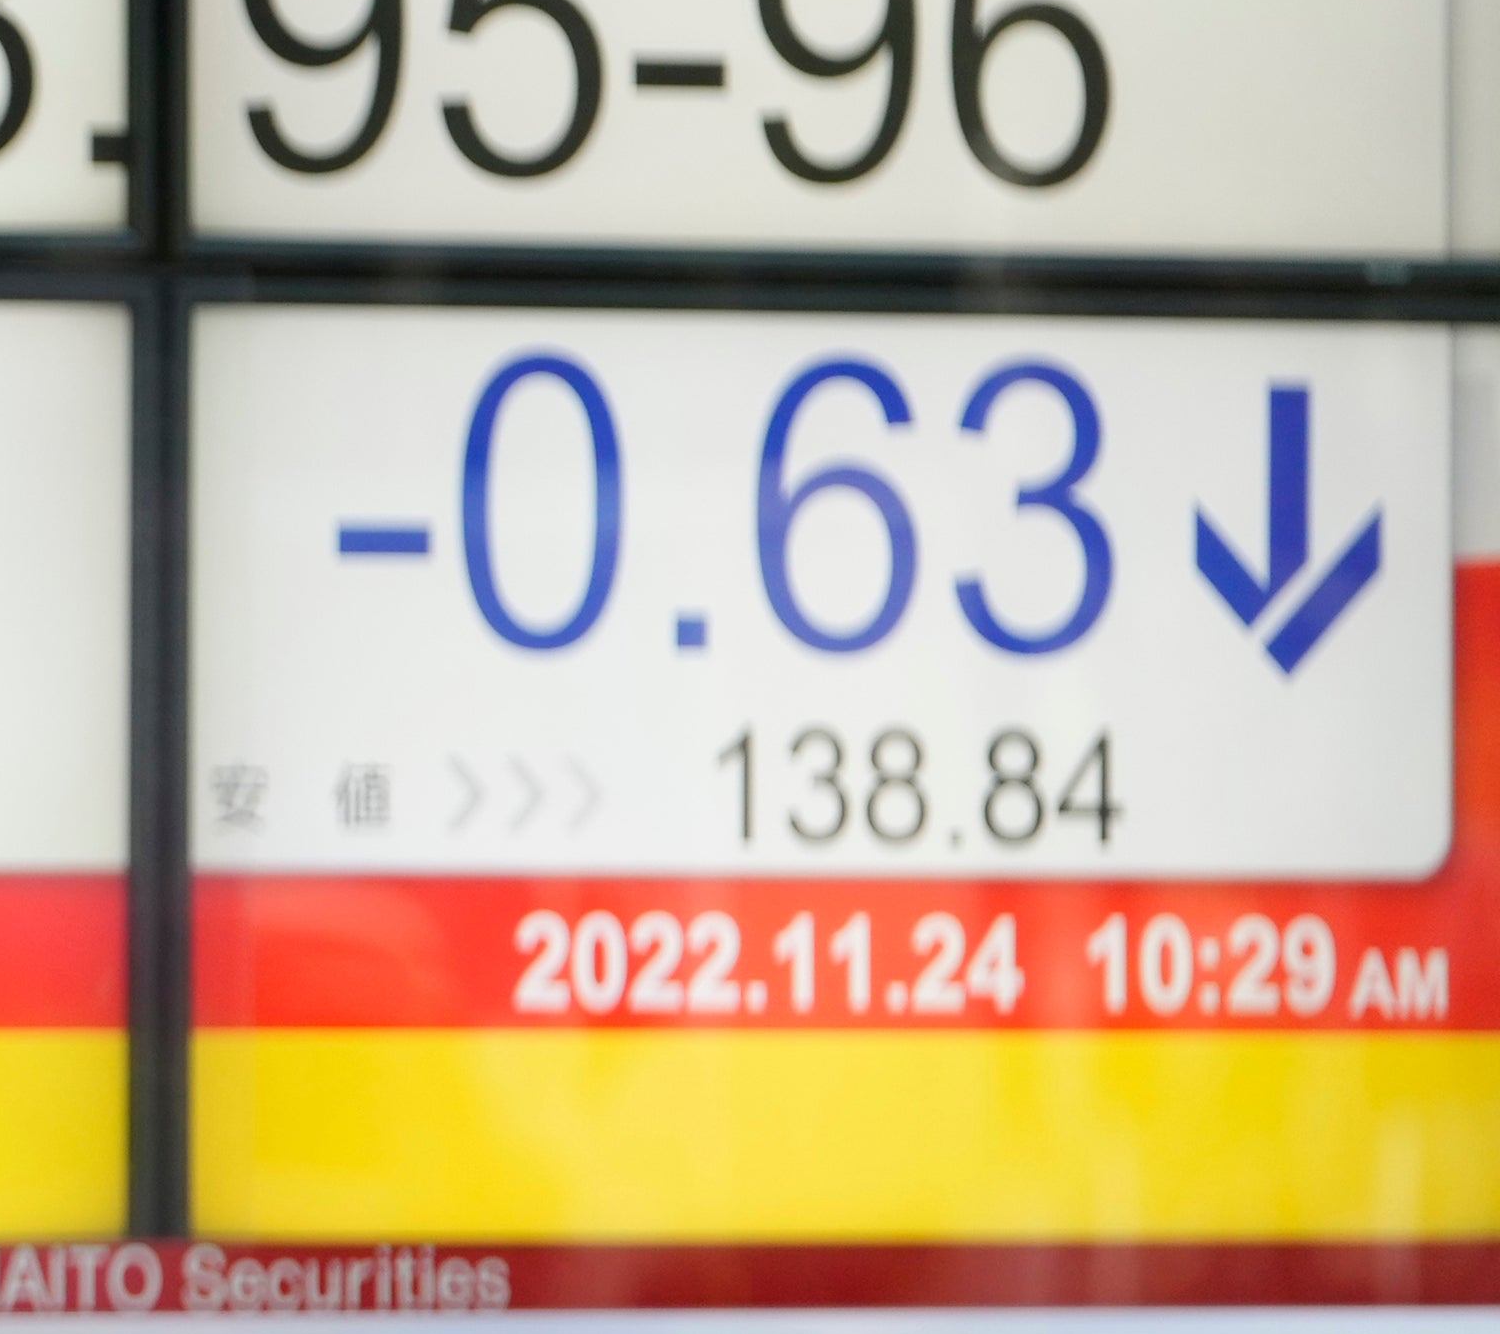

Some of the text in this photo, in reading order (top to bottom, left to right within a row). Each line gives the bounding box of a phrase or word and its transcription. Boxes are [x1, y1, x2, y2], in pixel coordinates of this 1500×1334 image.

[337, 351, 1115, 658] -0.63
[717, 726, 1124, 849] 138.84
[513, 909, 1451, 1021] 2022.11.24 10:29 AM
[181, 1243, 512, 1312] Securities
